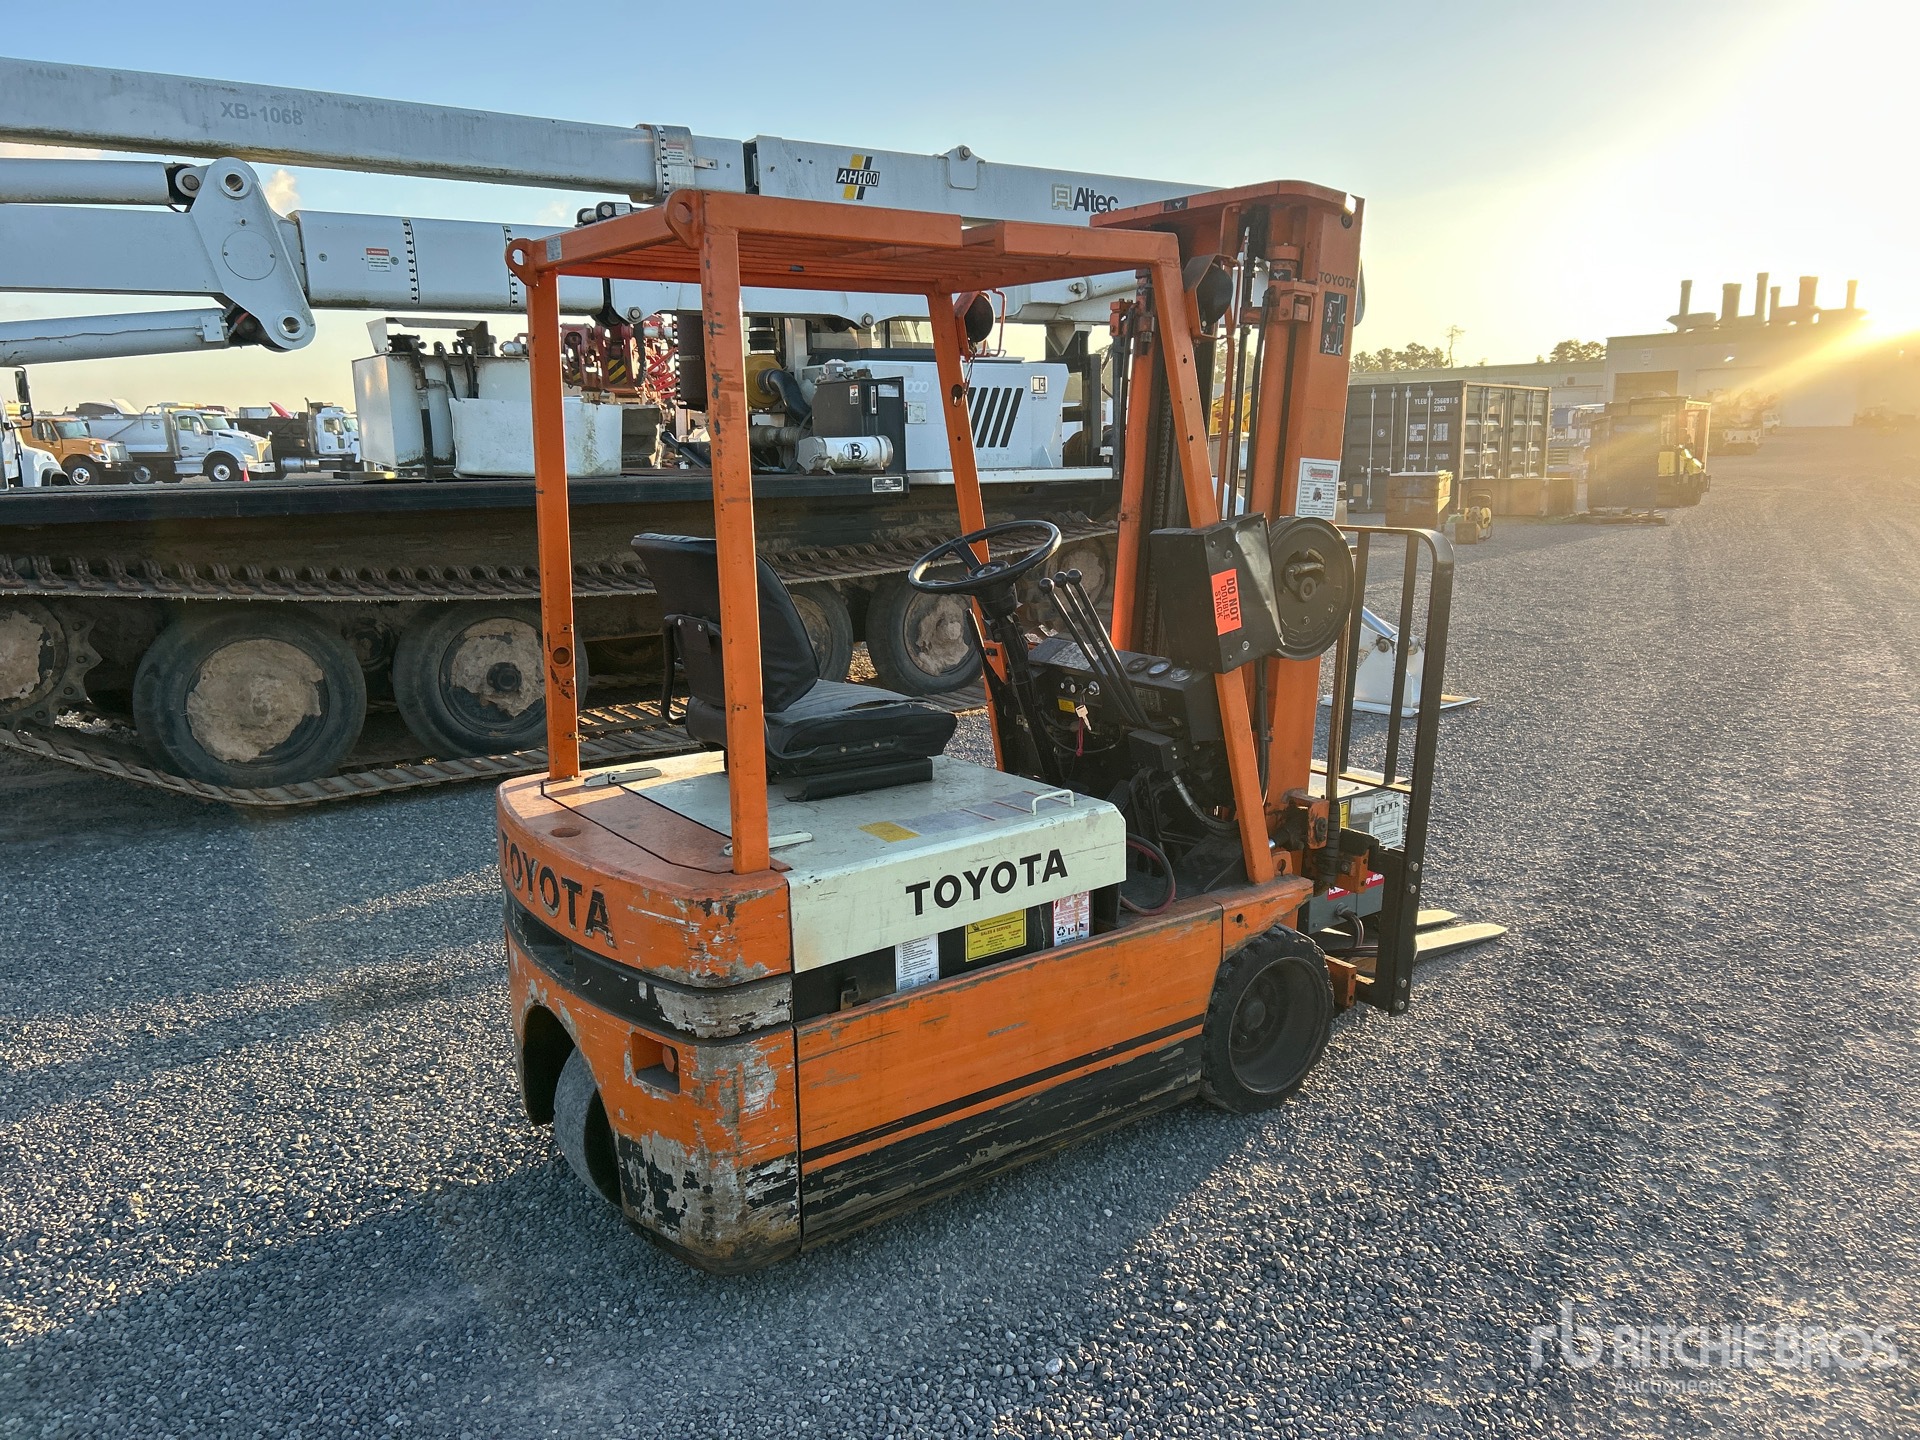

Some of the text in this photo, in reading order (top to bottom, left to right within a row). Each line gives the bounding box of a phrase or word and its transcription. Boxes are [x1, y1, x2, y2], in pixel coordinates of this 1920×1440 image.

[220, 101, 304, 126] XB-1068
[838, 169, 878, 185] AH100
[1073, 186, 1119, 213] Altec
[1319, 271, 1356, 289] TOYOTA
[1215, 590, 1223, 618] STACK
[1220, 585, 1230, 620] DOUBLE
[1226, 577, 1240, 621] DO NOT
[501, 829, 618, 950] TOYOTA
[905, 848, 1068, 916] TOYOTA
